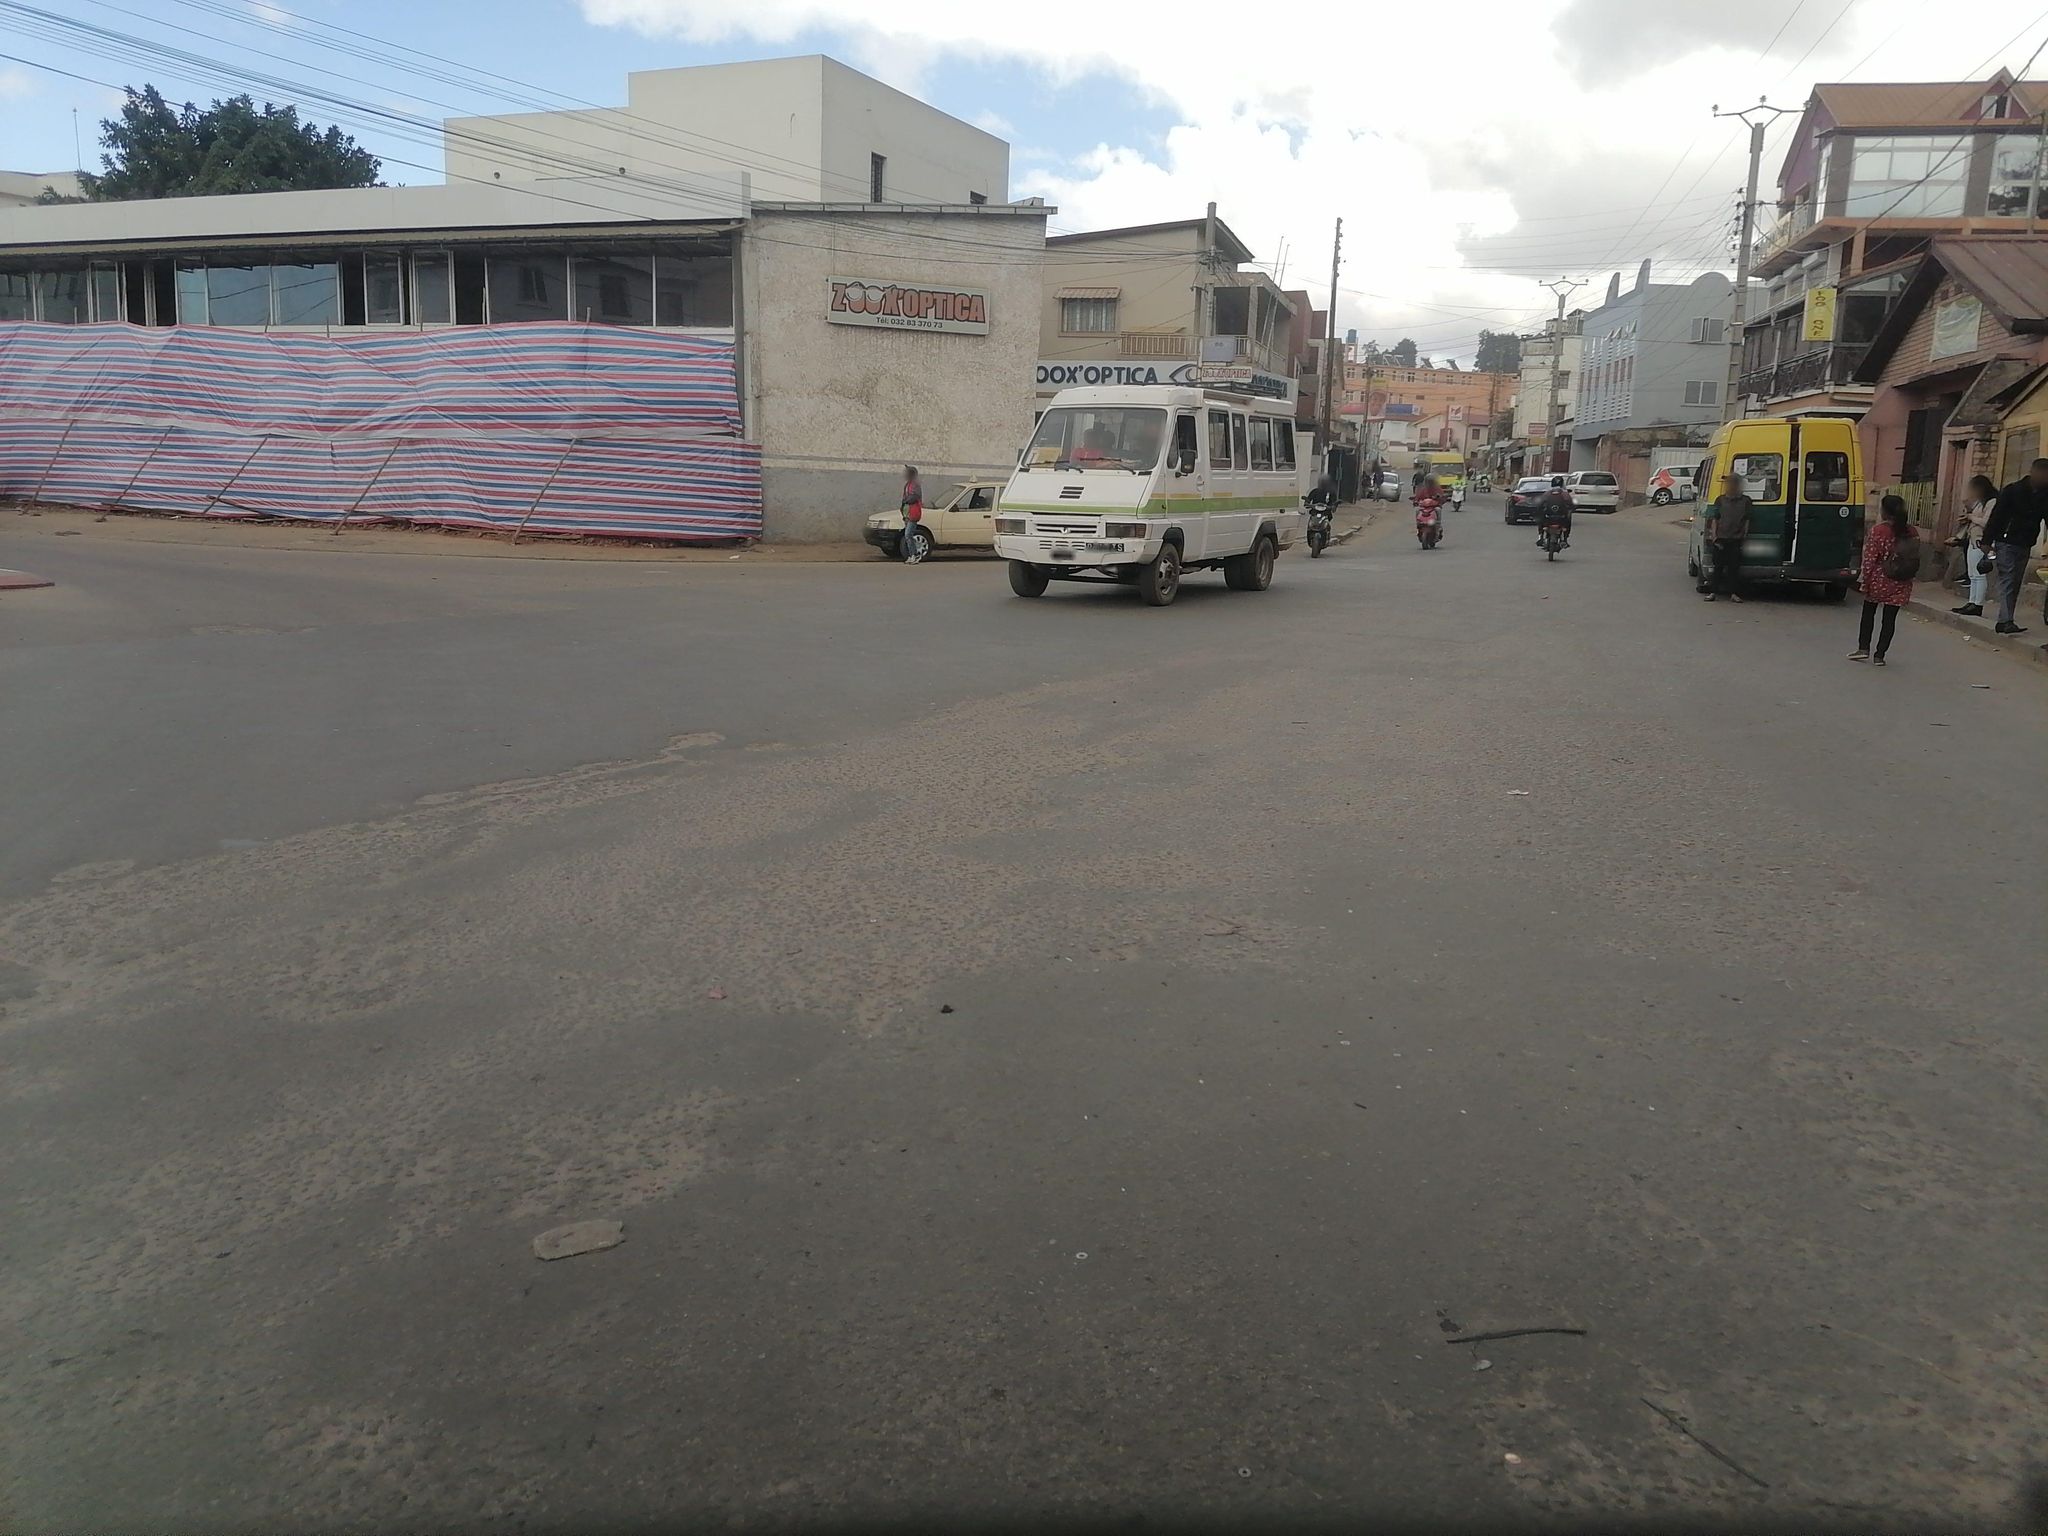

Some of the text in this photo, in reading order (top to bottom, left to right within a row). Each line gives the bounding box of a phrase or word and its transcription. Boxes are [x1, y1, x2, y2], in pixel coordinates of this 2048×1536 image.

[831, 281, 985, 323] ZOOX'OPTICA
[891, 318, 905, 326] 032
[917, 320, 932, 328] 370
[933, 321, 943, 329] 73
